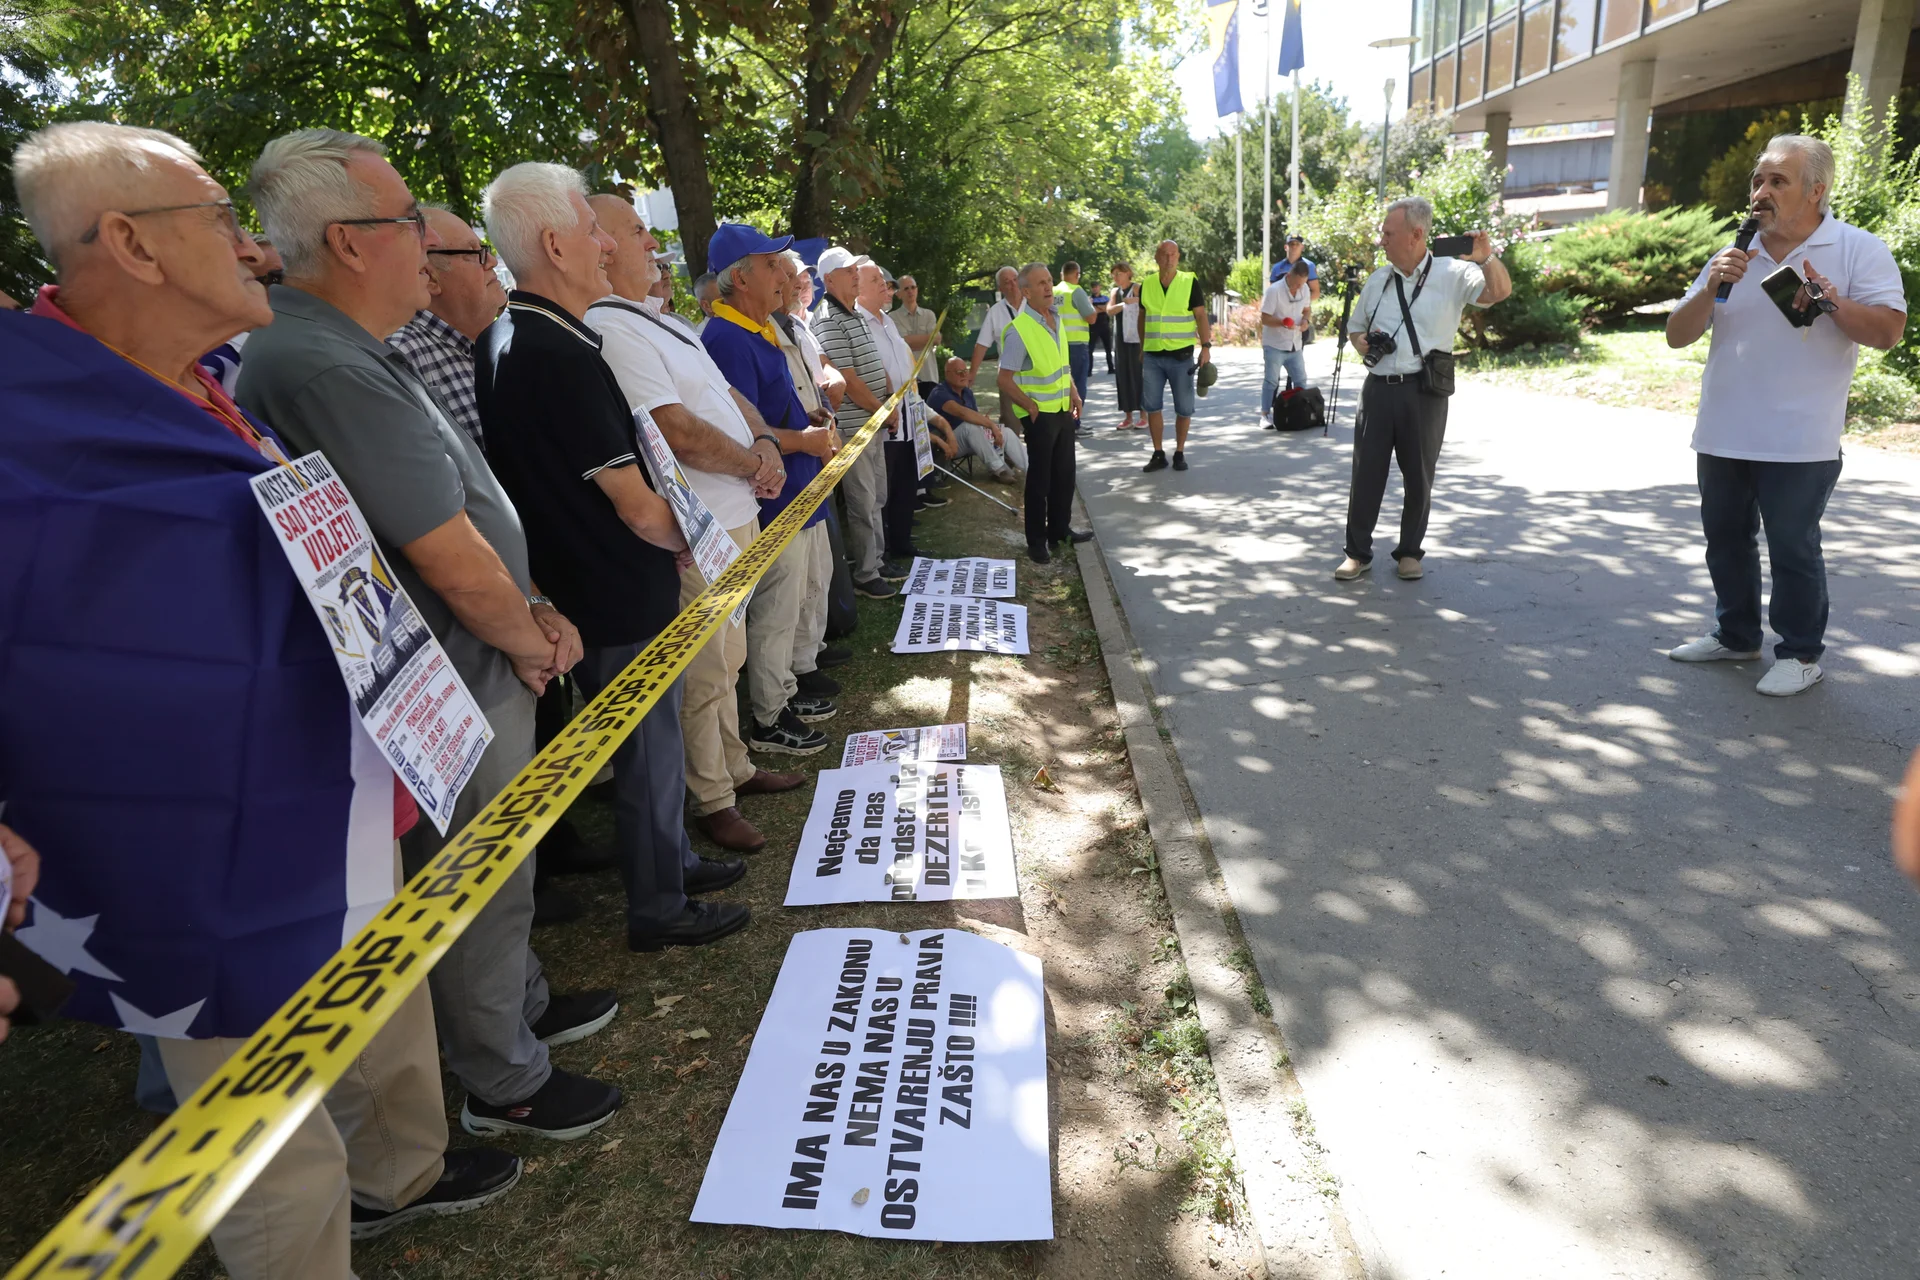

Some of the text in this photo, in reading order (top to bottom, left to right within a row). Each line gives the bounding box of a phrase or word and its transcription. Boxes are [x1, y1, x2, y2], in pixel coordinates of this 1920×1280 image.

[255, 472, 296, 509] NISTE
[300, 454, 333, 484] ČULI
[275, 504, 308, 542] SAD
[321, 480, 349, 511] NAS
[302, 508, 362, 573] VIDJETI!
[908, 602, 928, 645] PRVI SMO
[927, 609, 945, 644] KRENULI
[966, 613, 980, 641] ZADNJI
[984, 600, 999, 652] OSTVARENJU
[1003, 613, 1017, 643] PRAVA
[228, 935, 404, 1099] STOP
[418, 752, 584, 900] POLICIJA
[582, 679, 647, 734] STOP
[647, 603, 717, 667] POLICIJA
[712, 569, 748, 597] STOP
[816, 789, 856, 877] Nećemo
[855, 791, 886, 864] da nas
[924, 772, 950, 886] DEZERTER
[781, 938, 873, 1210] IMA NAS U ZAKONU
[843, 976, 903, 1147] NEMA NAS U
[880, 933, 945, 1230] OSTVARENJU PRAVA
[937, 1035, 976, 1130] ZAŠTO
